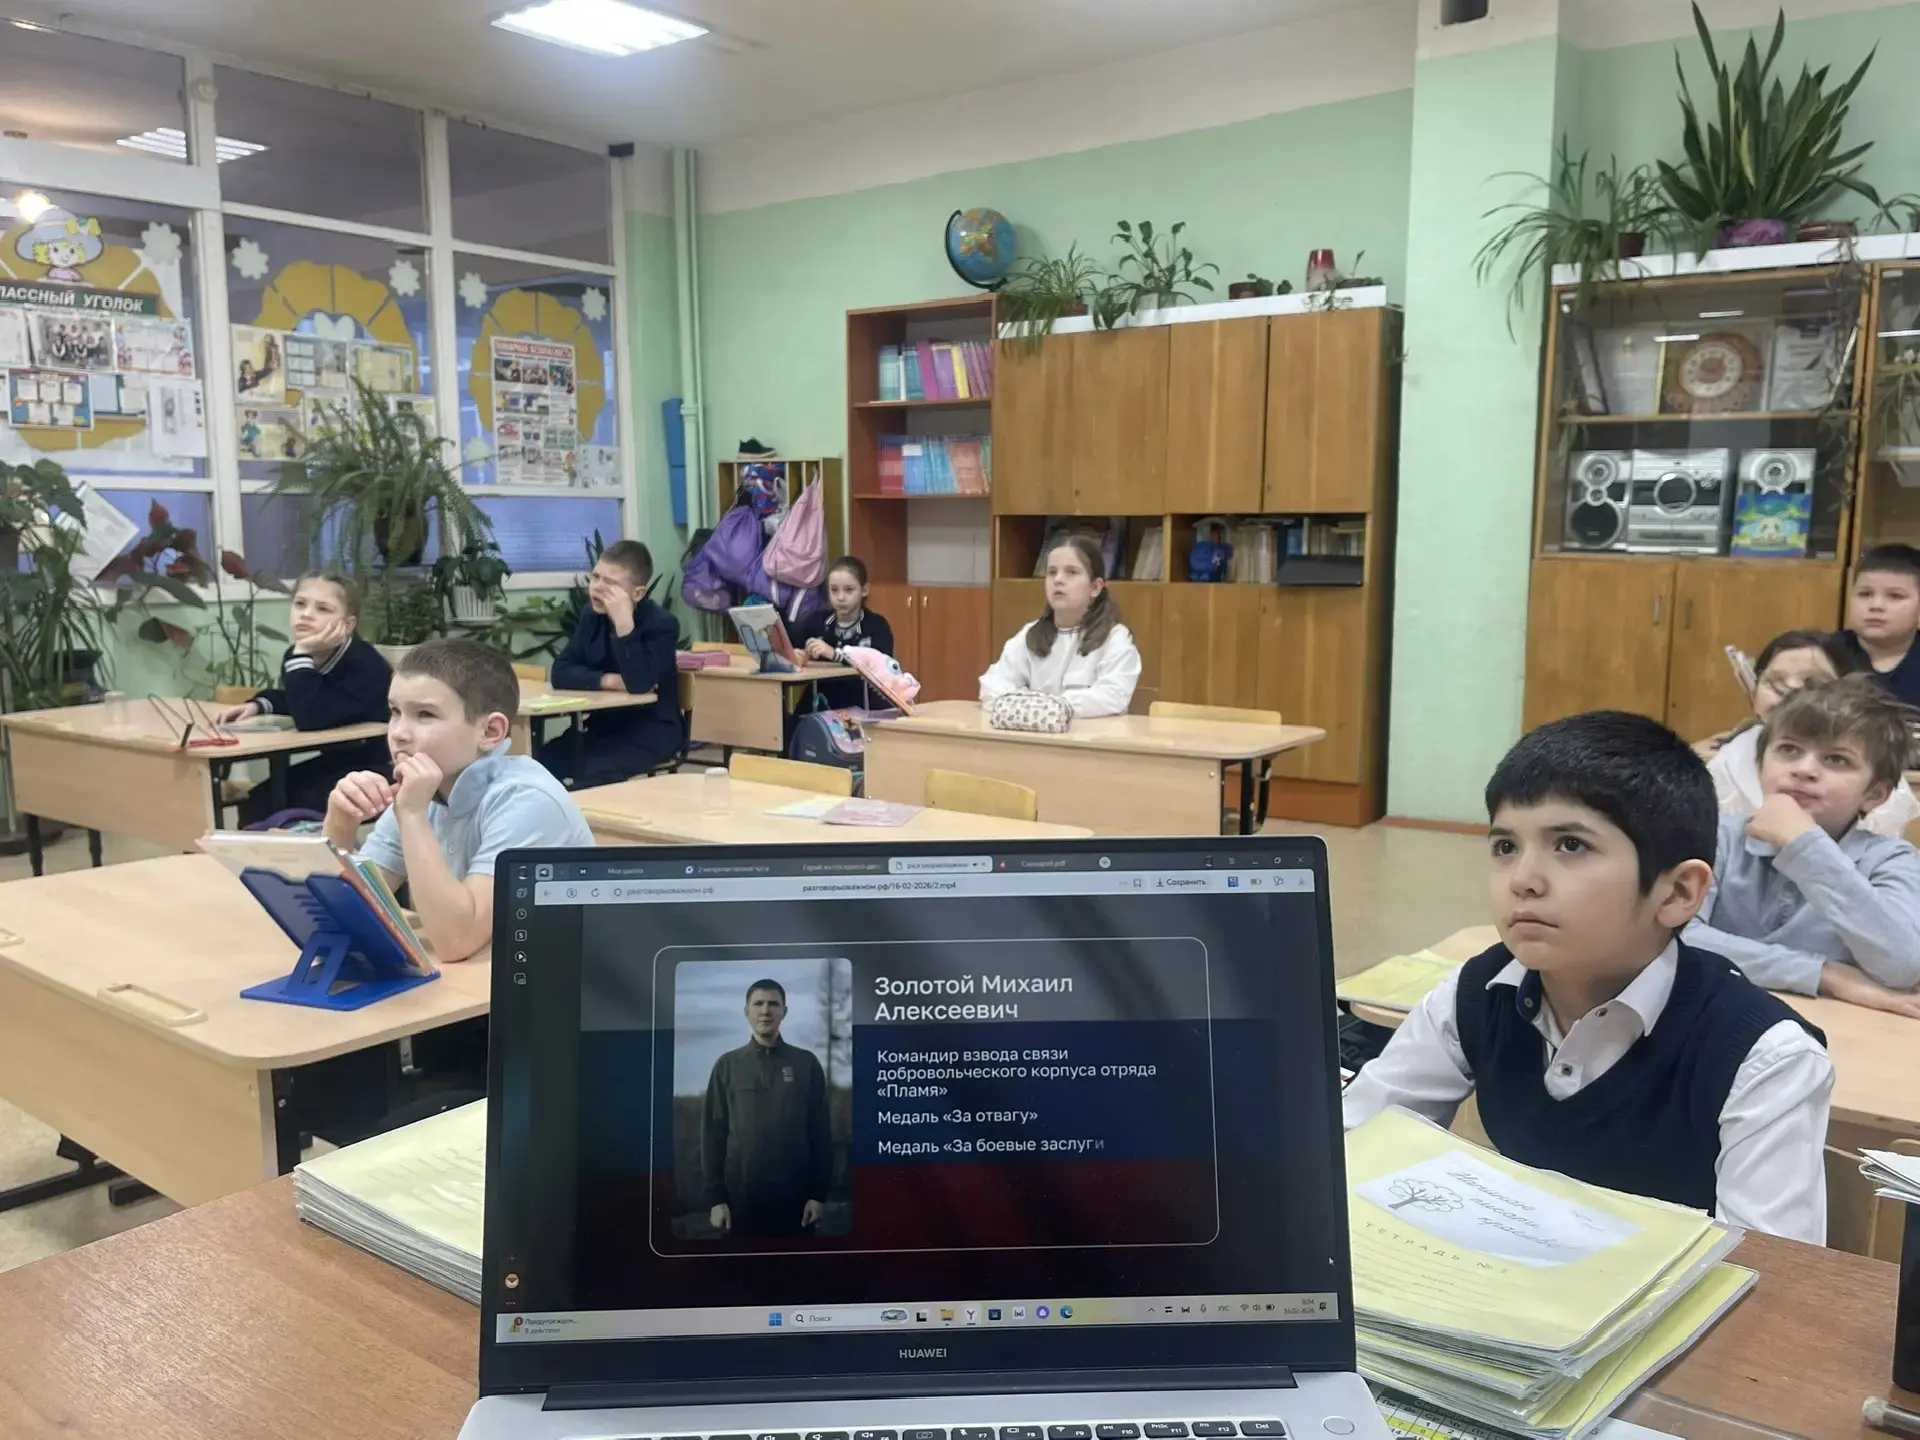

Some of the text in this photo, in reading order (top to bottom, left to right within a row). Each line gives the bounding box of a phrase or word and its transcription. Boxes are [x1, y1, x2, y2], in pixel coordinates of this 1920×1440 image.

[82, 293, 144, 312] УГОЛОК
[803, 881, 956, 893] разговорыоважном.рф/16-02-2026/2.mp4
[1166, 878, 1207, 887] Сохранить
[875, 975, 1073, 995] Золотой Михаил
[874, 1001, 1018, 1021] Алексеевич
[877, 1049, 1069, 1065] Командир взвода связи
[877, 1063, 1157, 1082] добровольческого корпуса отряда
[877, 1084, 948, 1098] «Пламя»
[878, 1109, 1038, 1125] Медаль «За отвагу»
[878, 1137, 1104, 1155] Медаль «За боевые заслуги
[1446, 1171, 1535, 1211] Начинаю
[1470, 1197, 1540, 1229] писать
[1365, 1221, 1460, 1261] ТЕТРАДЬ
[1477, 1216, 1562, 1248] красиво
[809, 1313, 832, 1323] Поиск
[899, 1348, 947, 1358] HUAWEI
[1403, 1406, 1416, 1414] Вт
[1424, 1412, 1441, 1422] Ср
[1450, 1420, 1461, 1428] Чт
